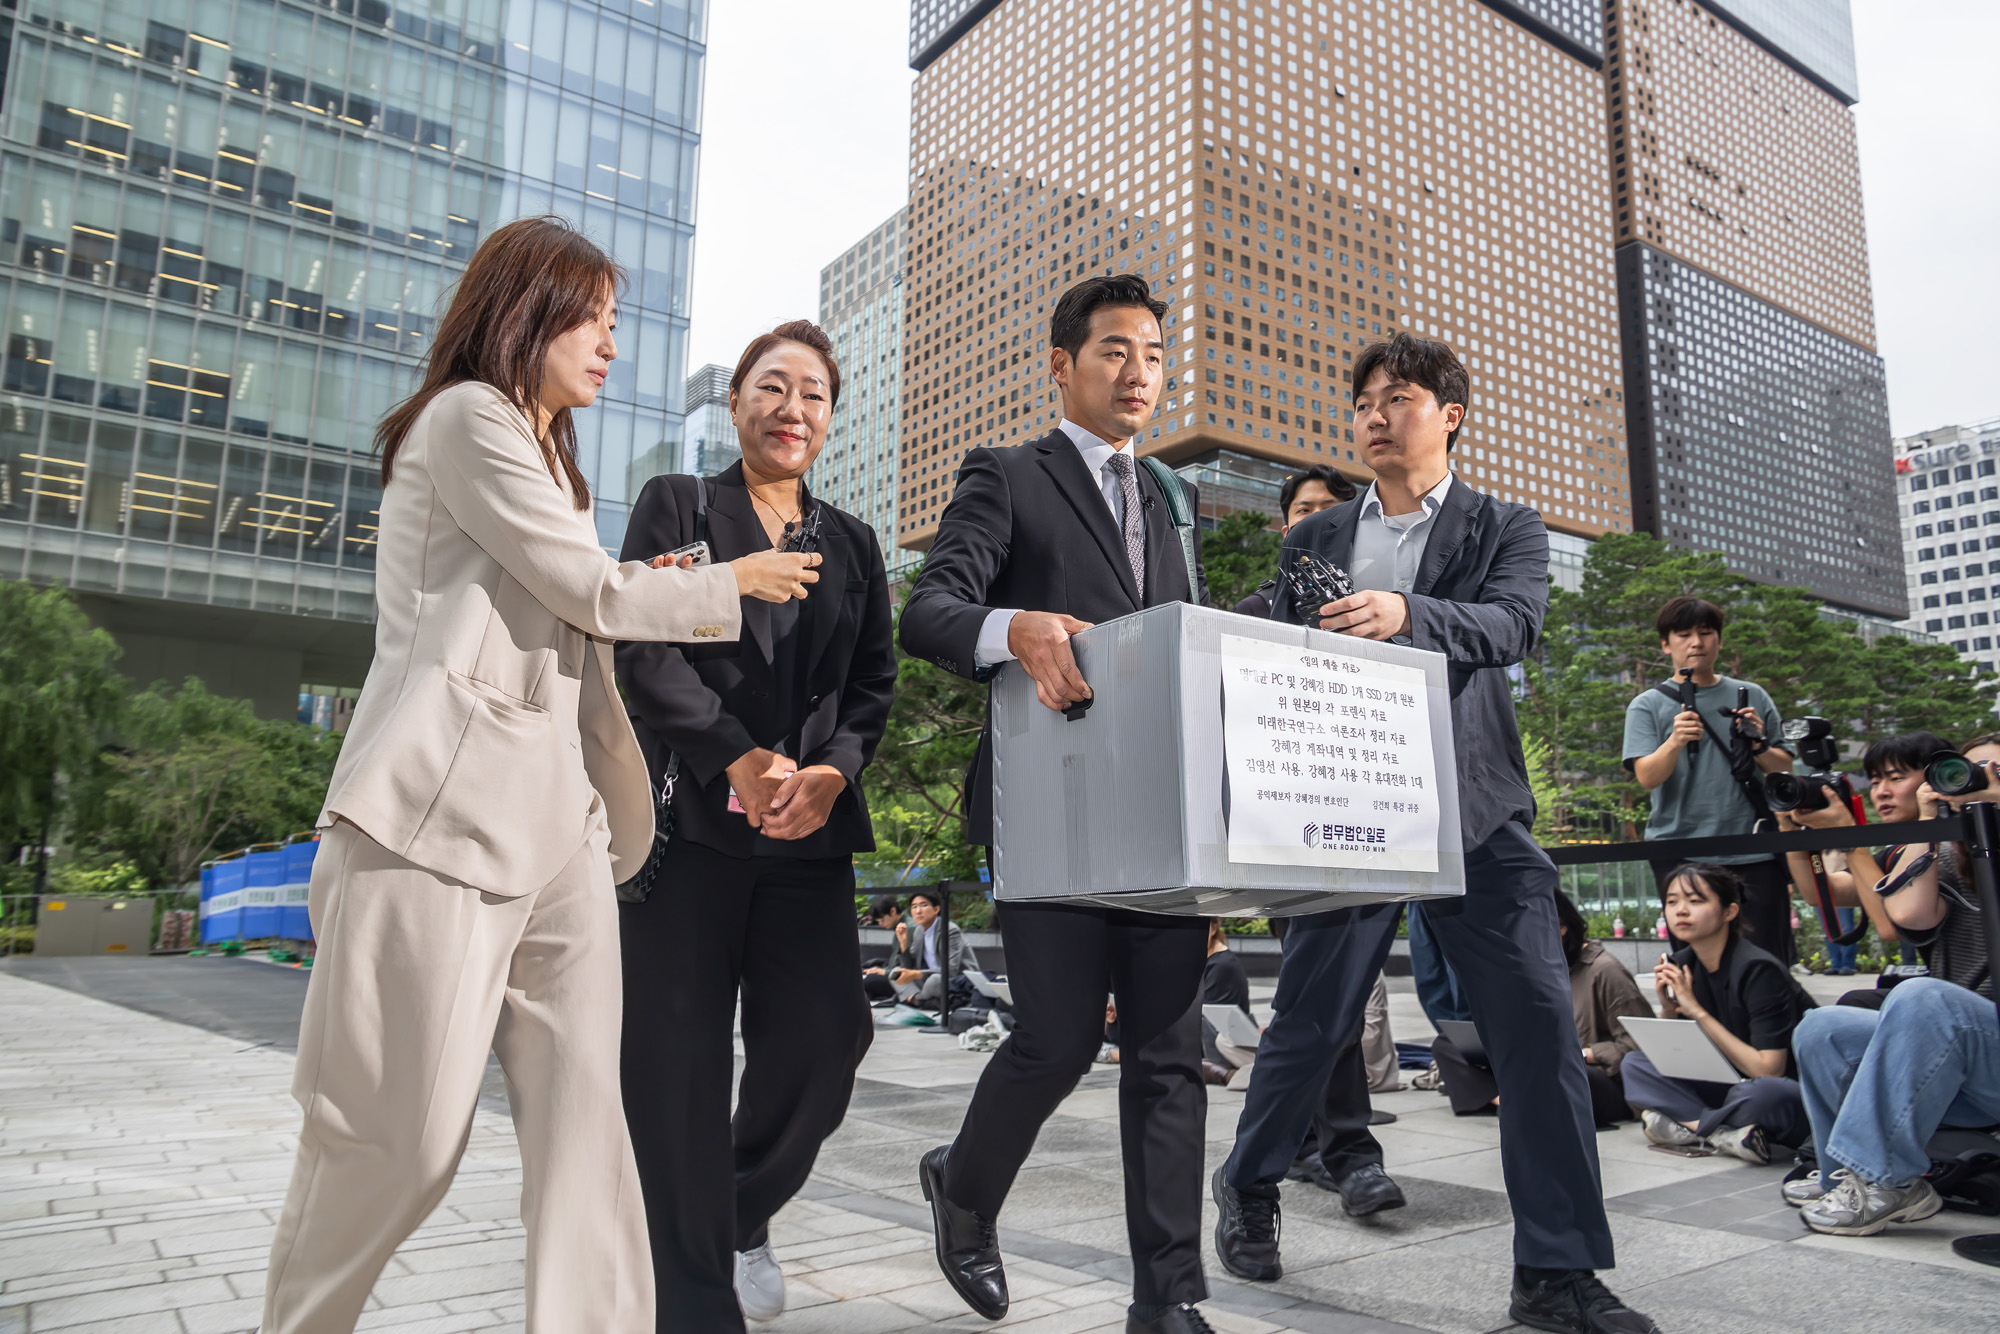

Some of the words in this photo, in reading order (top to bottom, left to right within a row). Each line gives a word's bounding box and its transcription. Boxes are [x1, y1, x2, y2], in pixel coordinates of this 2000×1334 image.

[1323, 659, 1338, 671] 제출
[1271, 673, 1284, 686] PC
[1287, 675, 1296, 689] 및
[1300, 677, 1325, 693] 강혜경
[1328, 682, 1347, 695] HDD
[1352, 685, 1364, 699] 1개
[1366, 687, 1382, 701] SSD
[1384, 691, 1397, 704] 2개
[1400, 693, 1415, 708] 원본
[1278, 696, 1287, 710] 위
[1292, 697, 1320, 714] 원본의
[1325, 702, 1334, 716] 각
[1340, 705, 1366, 720] 포렌식
[1370, 709, 1387, 722] 자료
[1257, 715, 1326, 735] 미래한국연구소
[1330, 724, 1366, 741] 여론조사
[1370, 729, 1386, 744] 정리
[1390, 732, 1407, 746] 자료
[1271, 739, 1301, 755] 강혜경
[1306, 742, 1344, 760] 계좌내역
[1348, 747, 1357, 761] 및
[1361, 749, 1378, 763] 정리
[1382, 752, 1399, 765] 자료
[1245, 758, 1276, 774] 김영선
[1308, 764, 1335, 781] 강혜경
[1340, 768, 1358, 783] 사용
[1362, 770, 1371, 784] 각
[1375, 771, 1407, 788] 휴대전화
[1410, 776, 1423, 789] 1대
[1256, 789, 1291, 802] 공익제보자
[1294, 792, 1321, 805] 강혜경의
[1323, 795, 1349, 808] 변호인단
[1372, 800, 1390, 811] 김건희
[1392, 801, 1404, 812] 특검
[1407, 803, 1419, 814] 귀중
